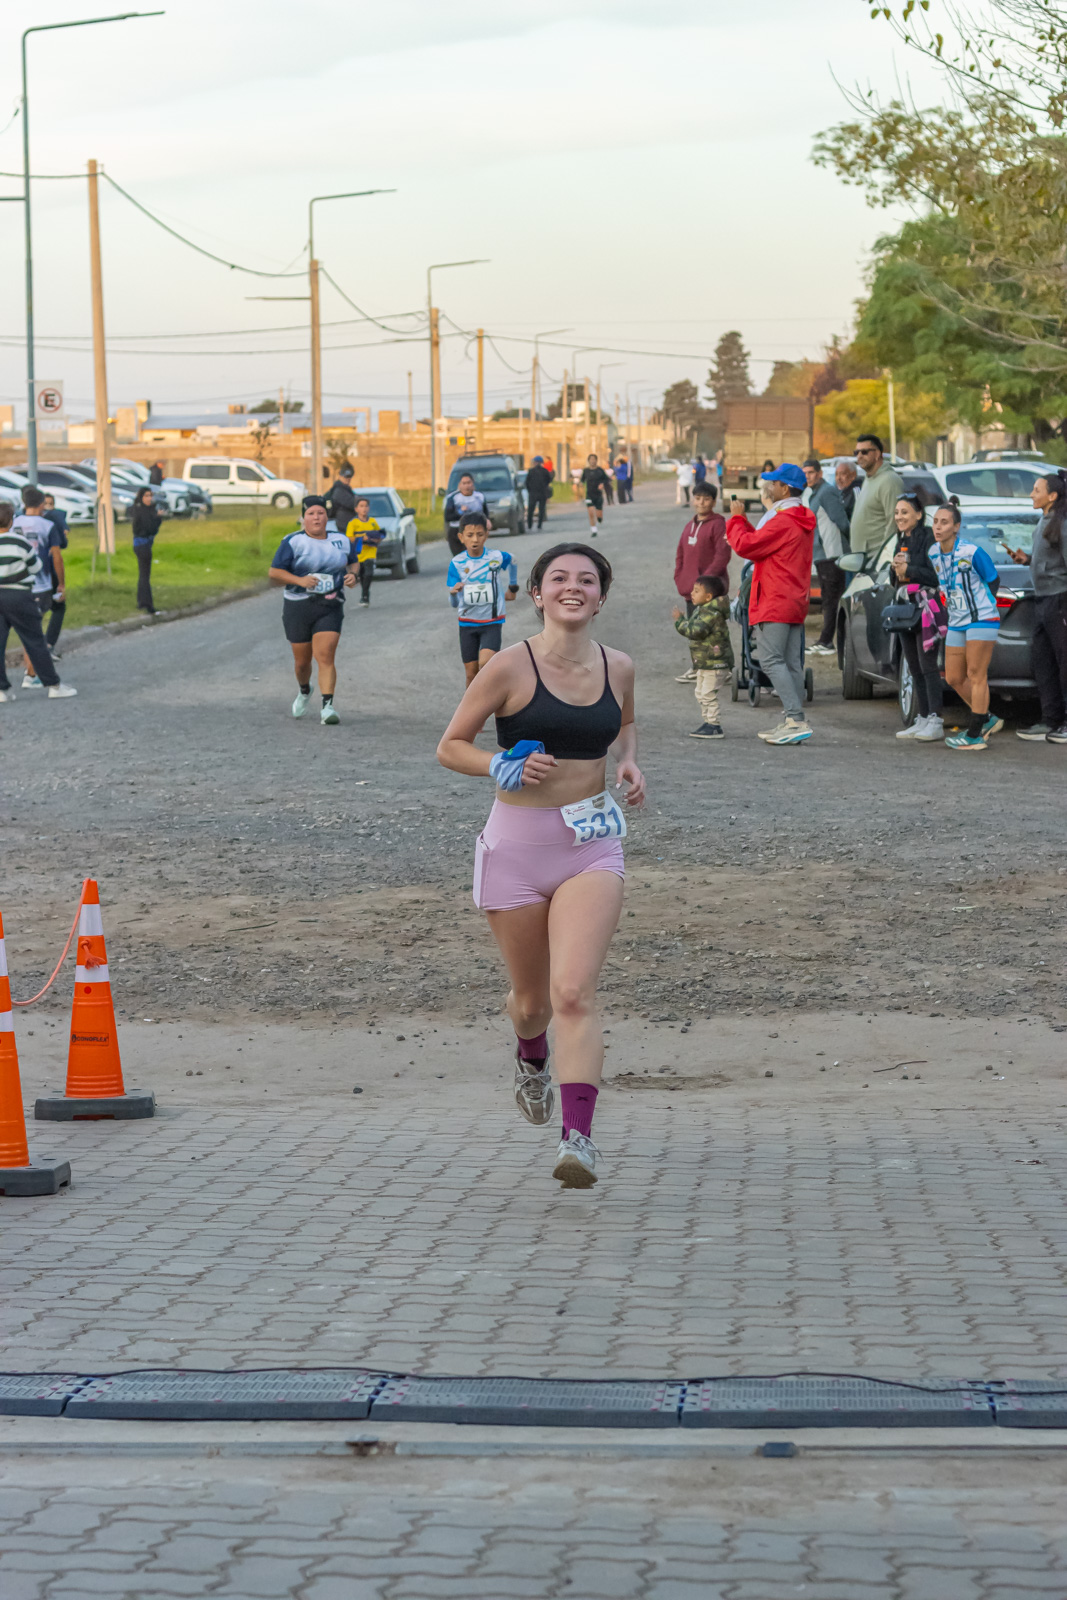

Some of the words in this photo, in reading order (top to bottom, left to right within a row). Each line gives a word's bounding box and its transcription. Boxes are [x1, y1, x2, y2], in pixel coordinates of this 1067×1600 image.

[45, 394, 56, 407] E
[468, 591, 489, 604] 171
[572, 807, 621, 842] 531
